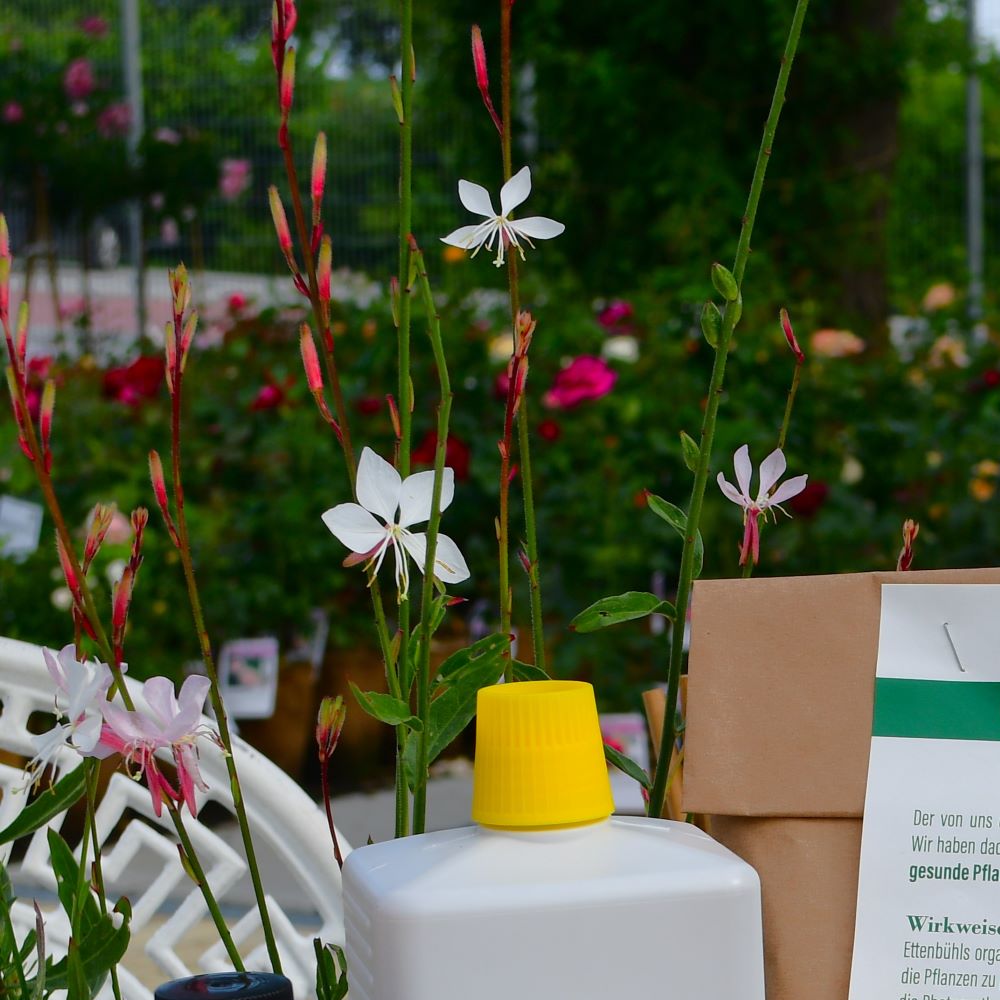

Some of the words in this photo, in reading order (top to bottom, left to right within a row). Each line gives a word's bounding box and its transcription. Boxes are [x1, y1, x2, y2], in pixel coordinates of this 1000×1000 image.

[913, 809, 934, 826] Der
[940, 813, 962, 827] von
[969, 815, 992, 828] uns
[911, 834, 933, 852] Wir
[936, 835, 975, 854] haben
[908, 862, 969, 882] gesunde
[903, 941, 970, 960] Ettenbühls
